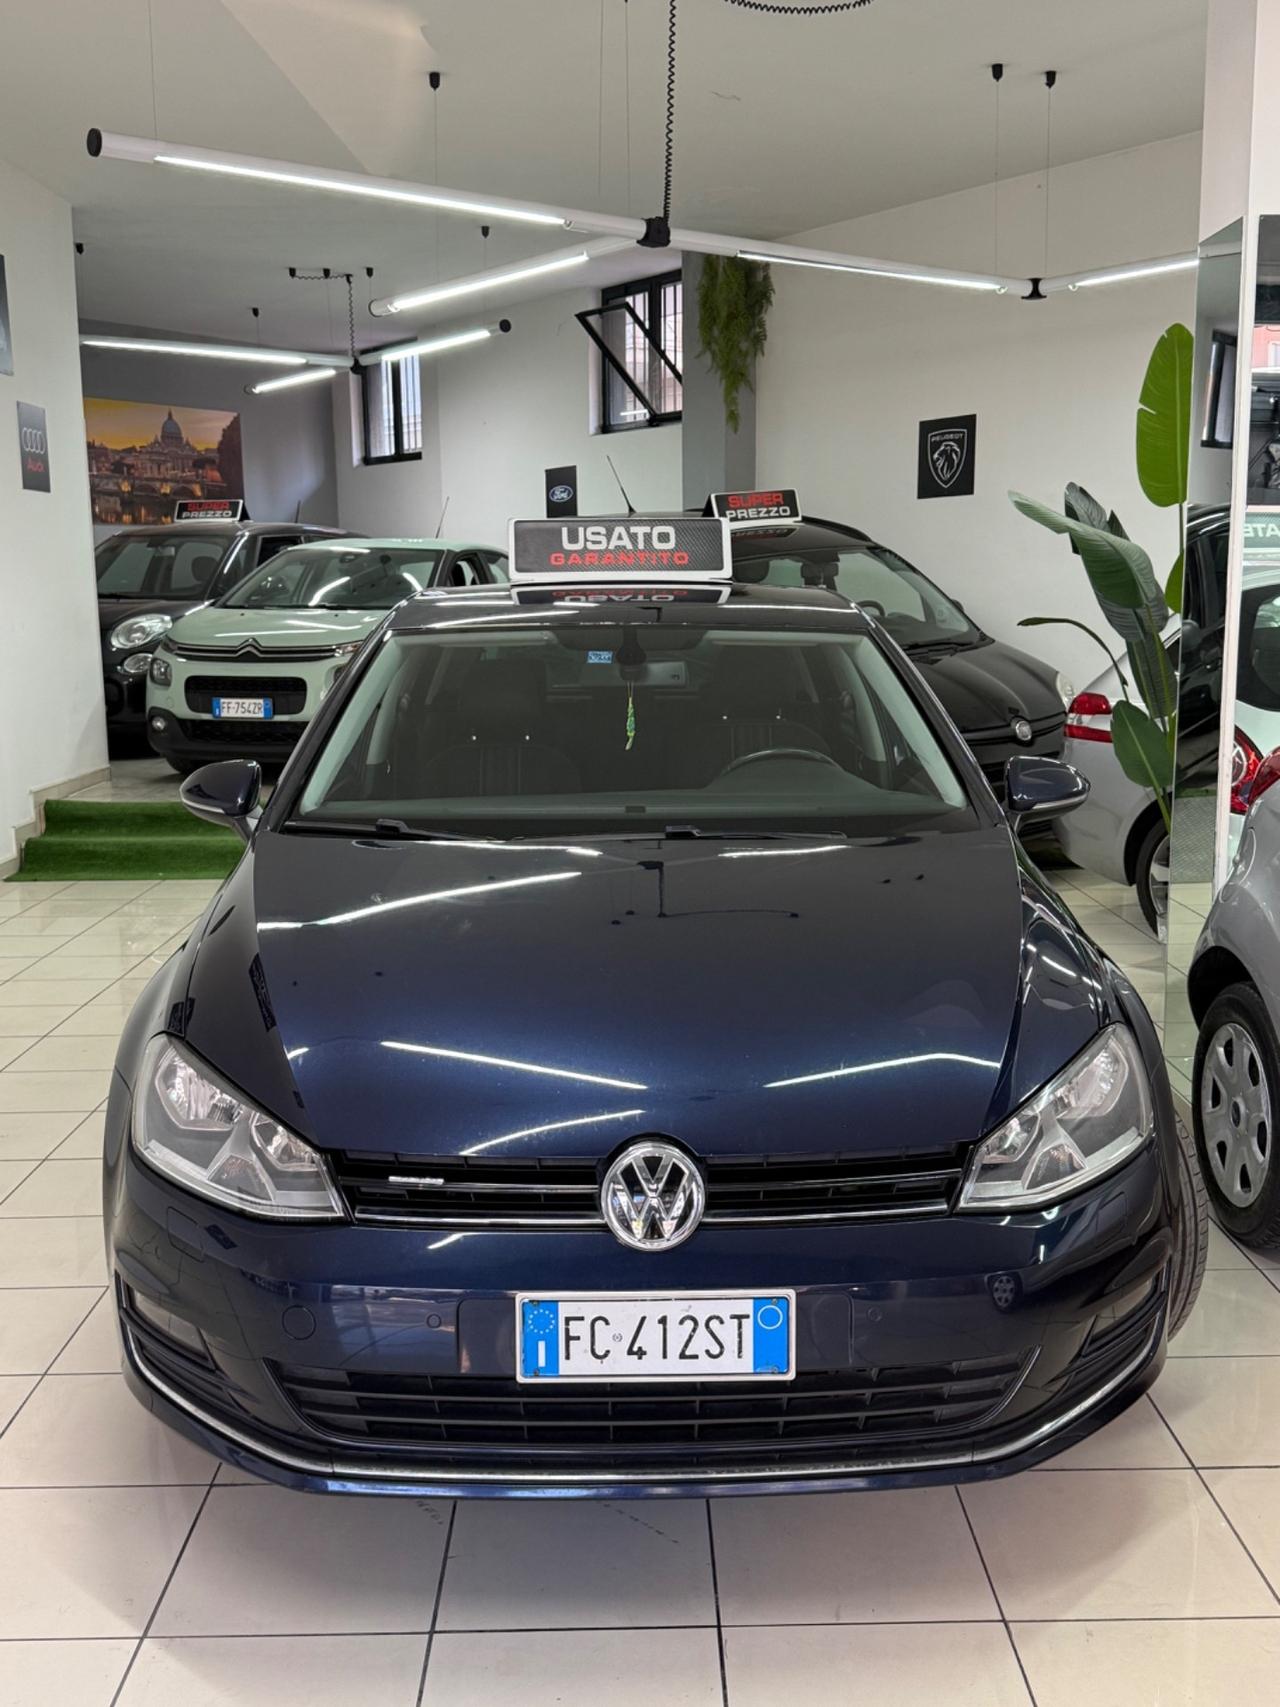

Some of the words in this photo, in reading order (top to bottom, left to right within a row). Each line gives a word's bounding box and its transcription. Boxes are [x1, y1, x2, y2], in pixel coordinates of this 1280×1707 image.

[187, 501, 230, 510] SUPER
[727, 492, 784, 508] SUPER
[182, 510, 232, 518] PREZZO
[725, 506, 791, 519] PREZZO
[561, 525, 676, 550] USATO
[549, 551, 689, 566] GARANTITO
